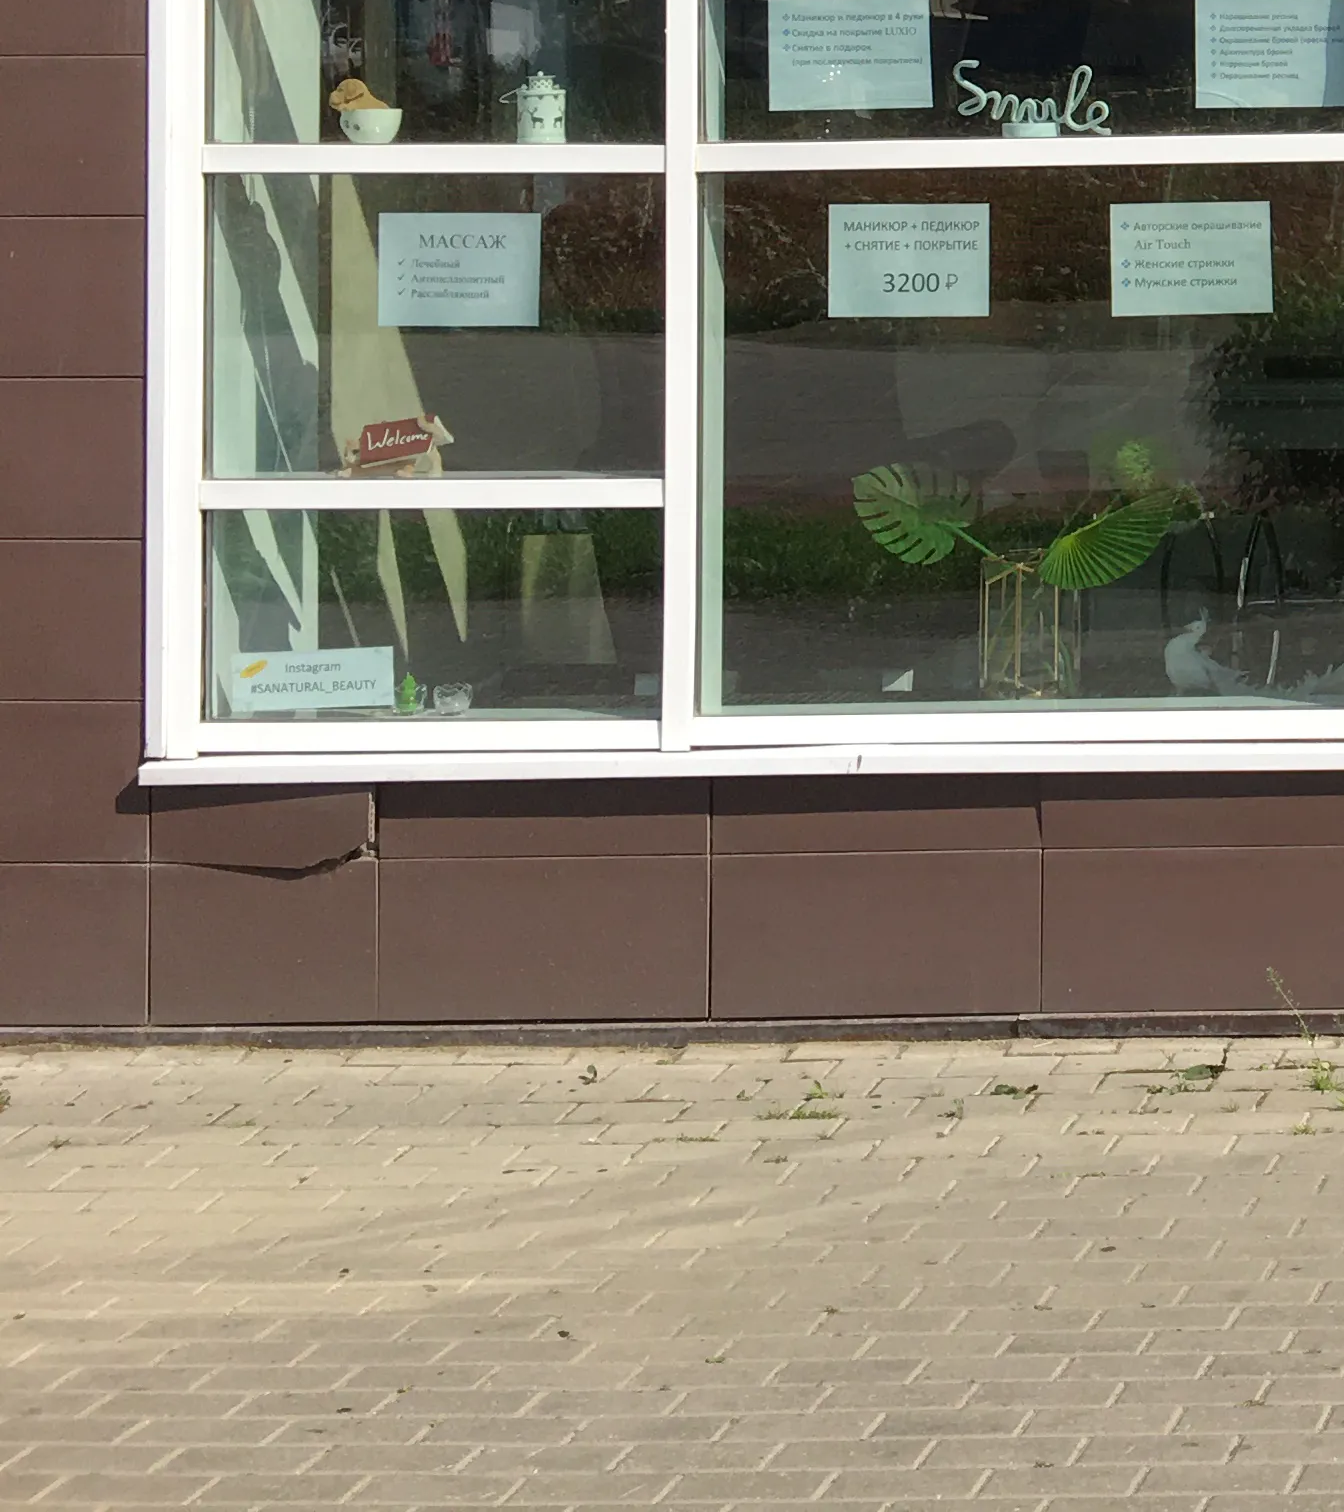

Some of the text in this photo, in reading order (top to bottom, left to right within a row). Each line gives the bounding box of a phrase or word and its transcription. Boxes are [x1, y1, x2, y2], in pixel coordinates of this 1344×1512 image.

[885, 27, 917, 36] LUXIO
[843, 221, 908, 232] МАНИКЮР
[921, 220, 980, 233] ПЕДИКЮР
[1133, 221, 1262, 232] Авторские окрашивание
[419, 234, 506, 249] МАССАЖ
[854, 240, 900, 251] СНЯТИЕ
[914, 240, 978, 251] ПОКРЫТИЕ
[1134, 238, 1191, 250] Air Touch
[1134, 259, 1235, 269] Женские стрижки
[882, 273, 940, 293] 3200
[1134, 277, 1237, 289] Мужские стрижки
[367, 428, 428, 450] Welcome
